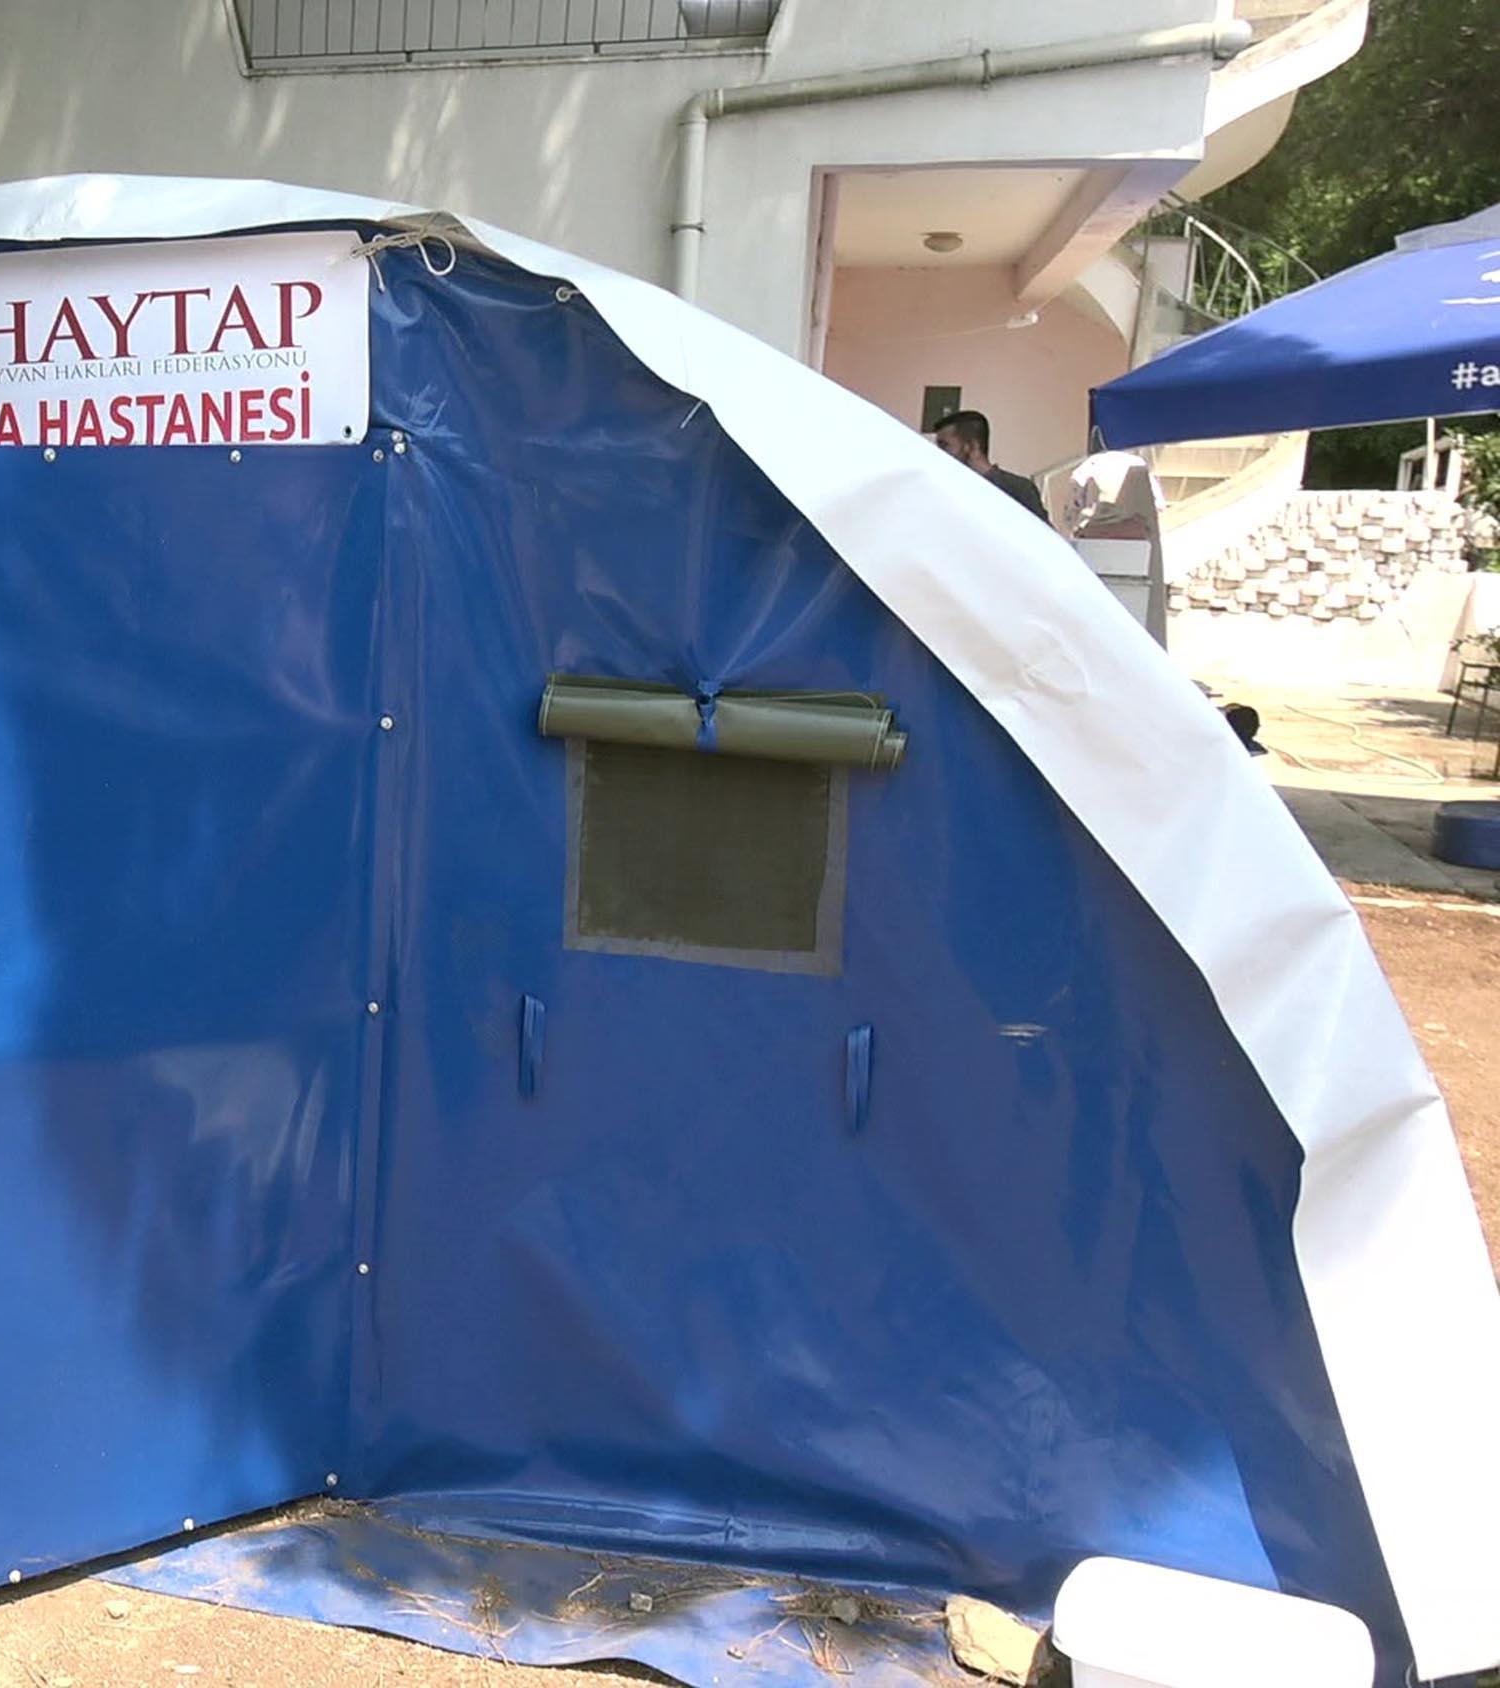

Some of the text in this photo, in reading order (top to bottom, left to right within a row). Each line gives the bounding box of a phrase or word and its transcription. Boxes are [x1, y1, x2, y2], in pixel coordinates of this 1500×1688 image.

[55, 360, 142, 381] HAKLARI
[152, 350, 308, 376] FEDERASYONU
[39, 370, 312, 446] HASTANESİ
